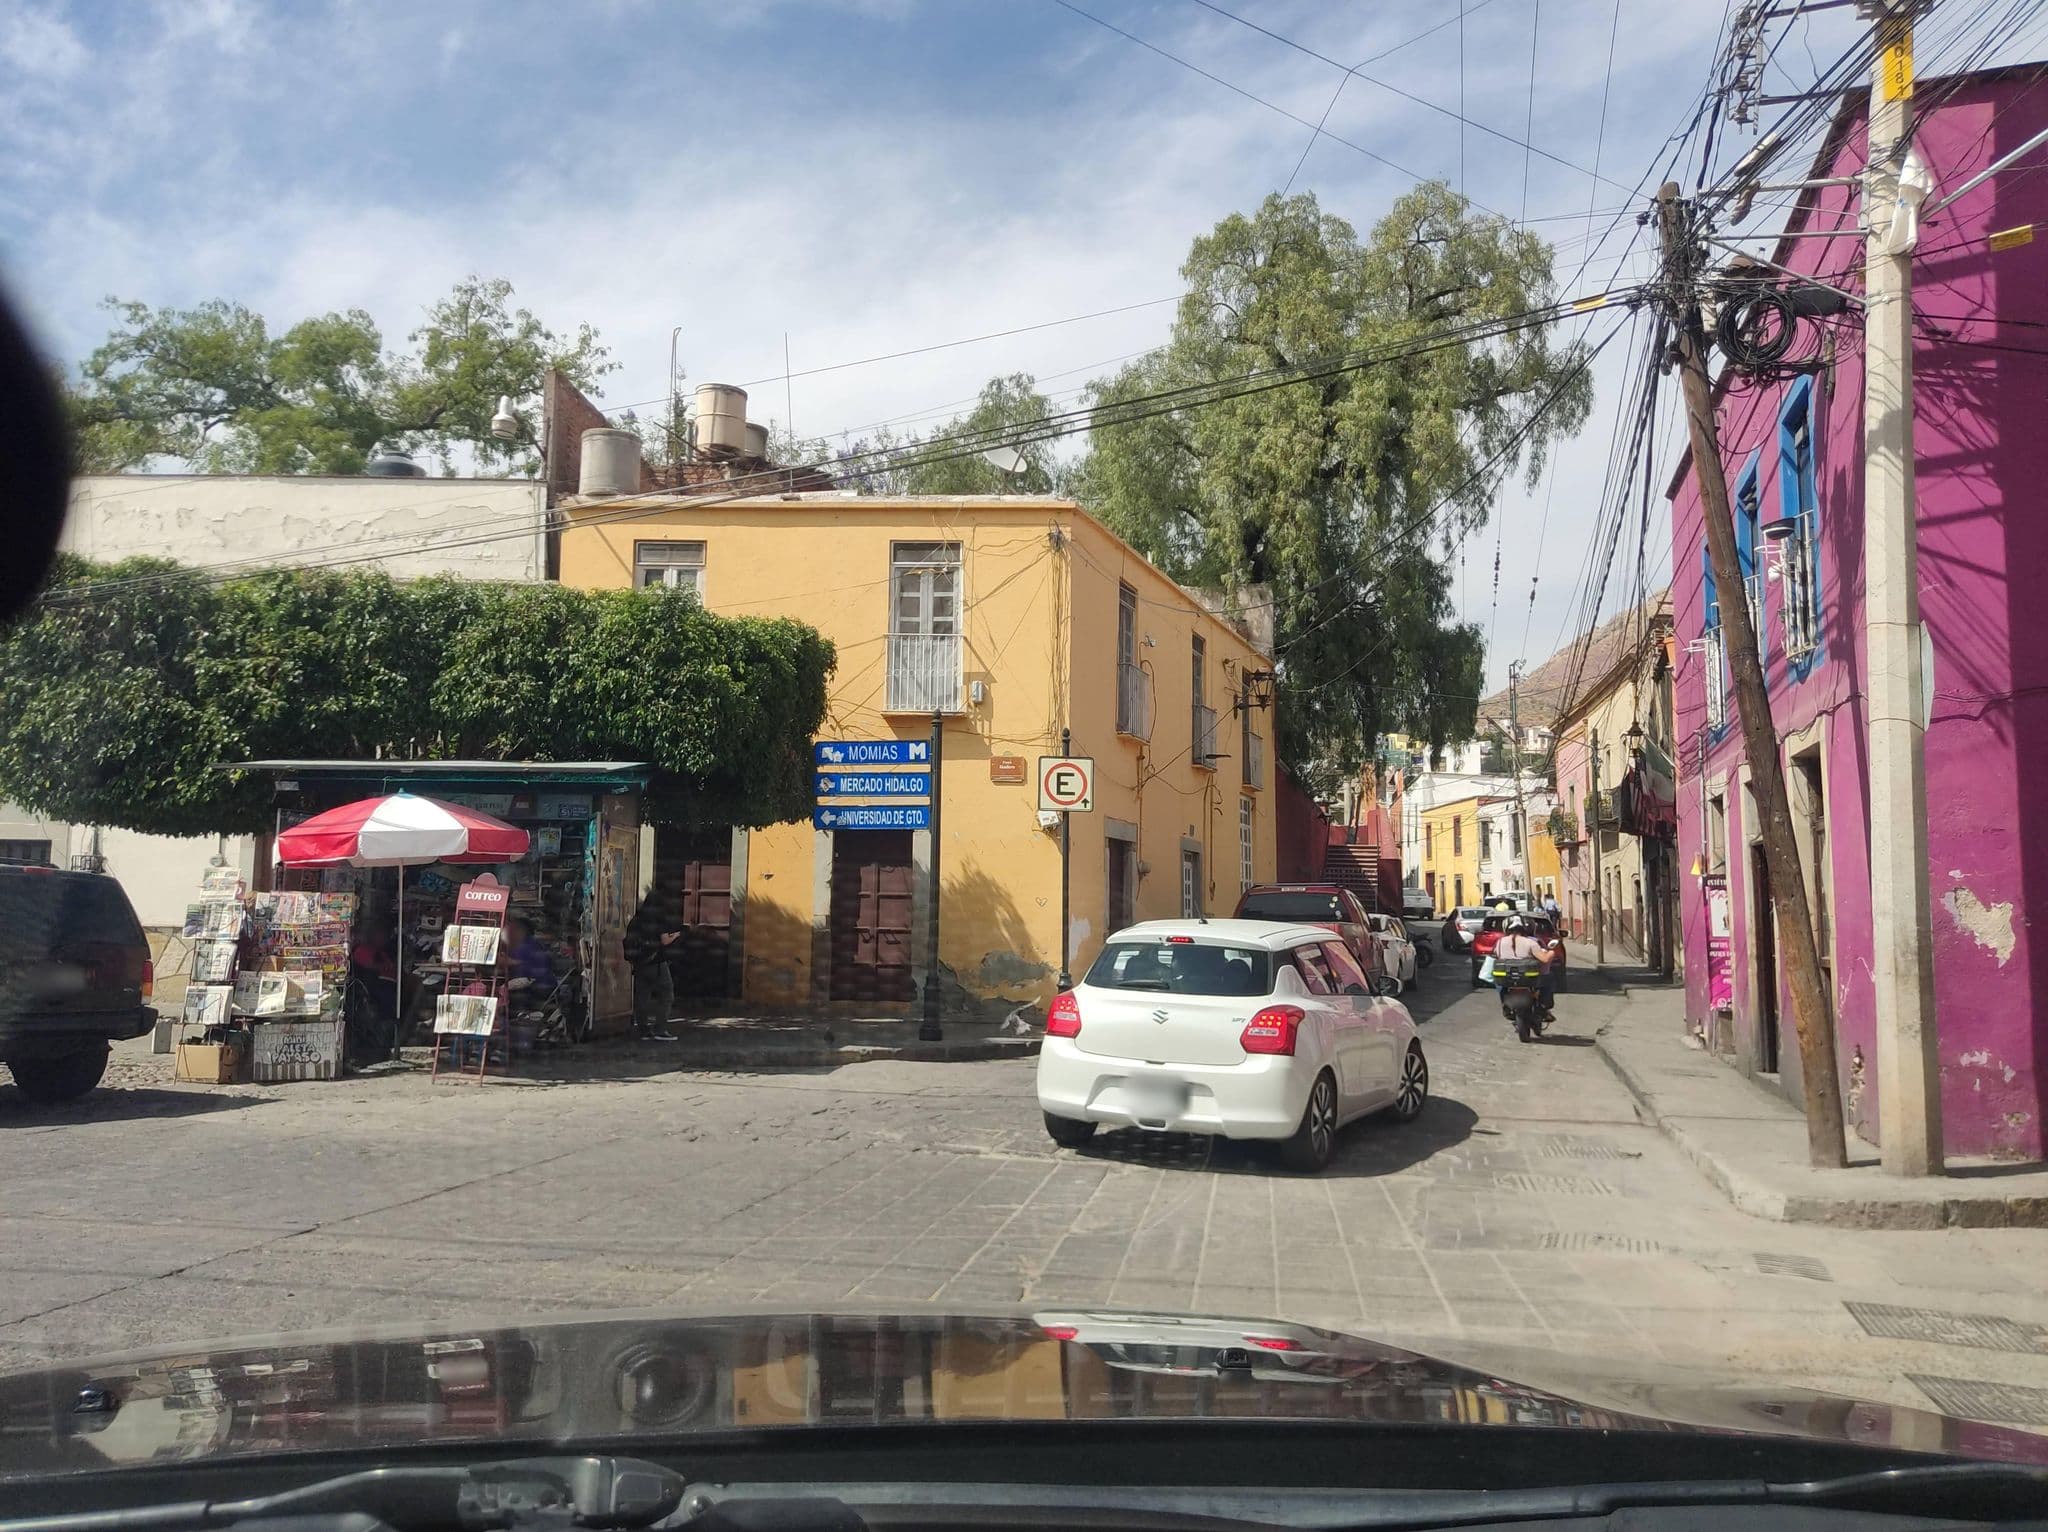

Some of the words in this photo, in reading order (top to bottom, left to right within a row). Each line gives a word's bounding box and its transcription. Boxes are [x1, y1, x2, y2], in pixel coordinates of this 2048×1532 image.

[848, 745, 898, 760] MOMIAS
[840, 777, 882, 792] MERCADO
[885, 777, 923, 792] HIDALGO
[1056, 772, 1075, 795] E
[841, 810, 892, 824] UNIVERSIDAD
[894, 810, 904, 824] DE
[906, 810, 924, 825] GTO.
[465, 891, 502, 902] correo
